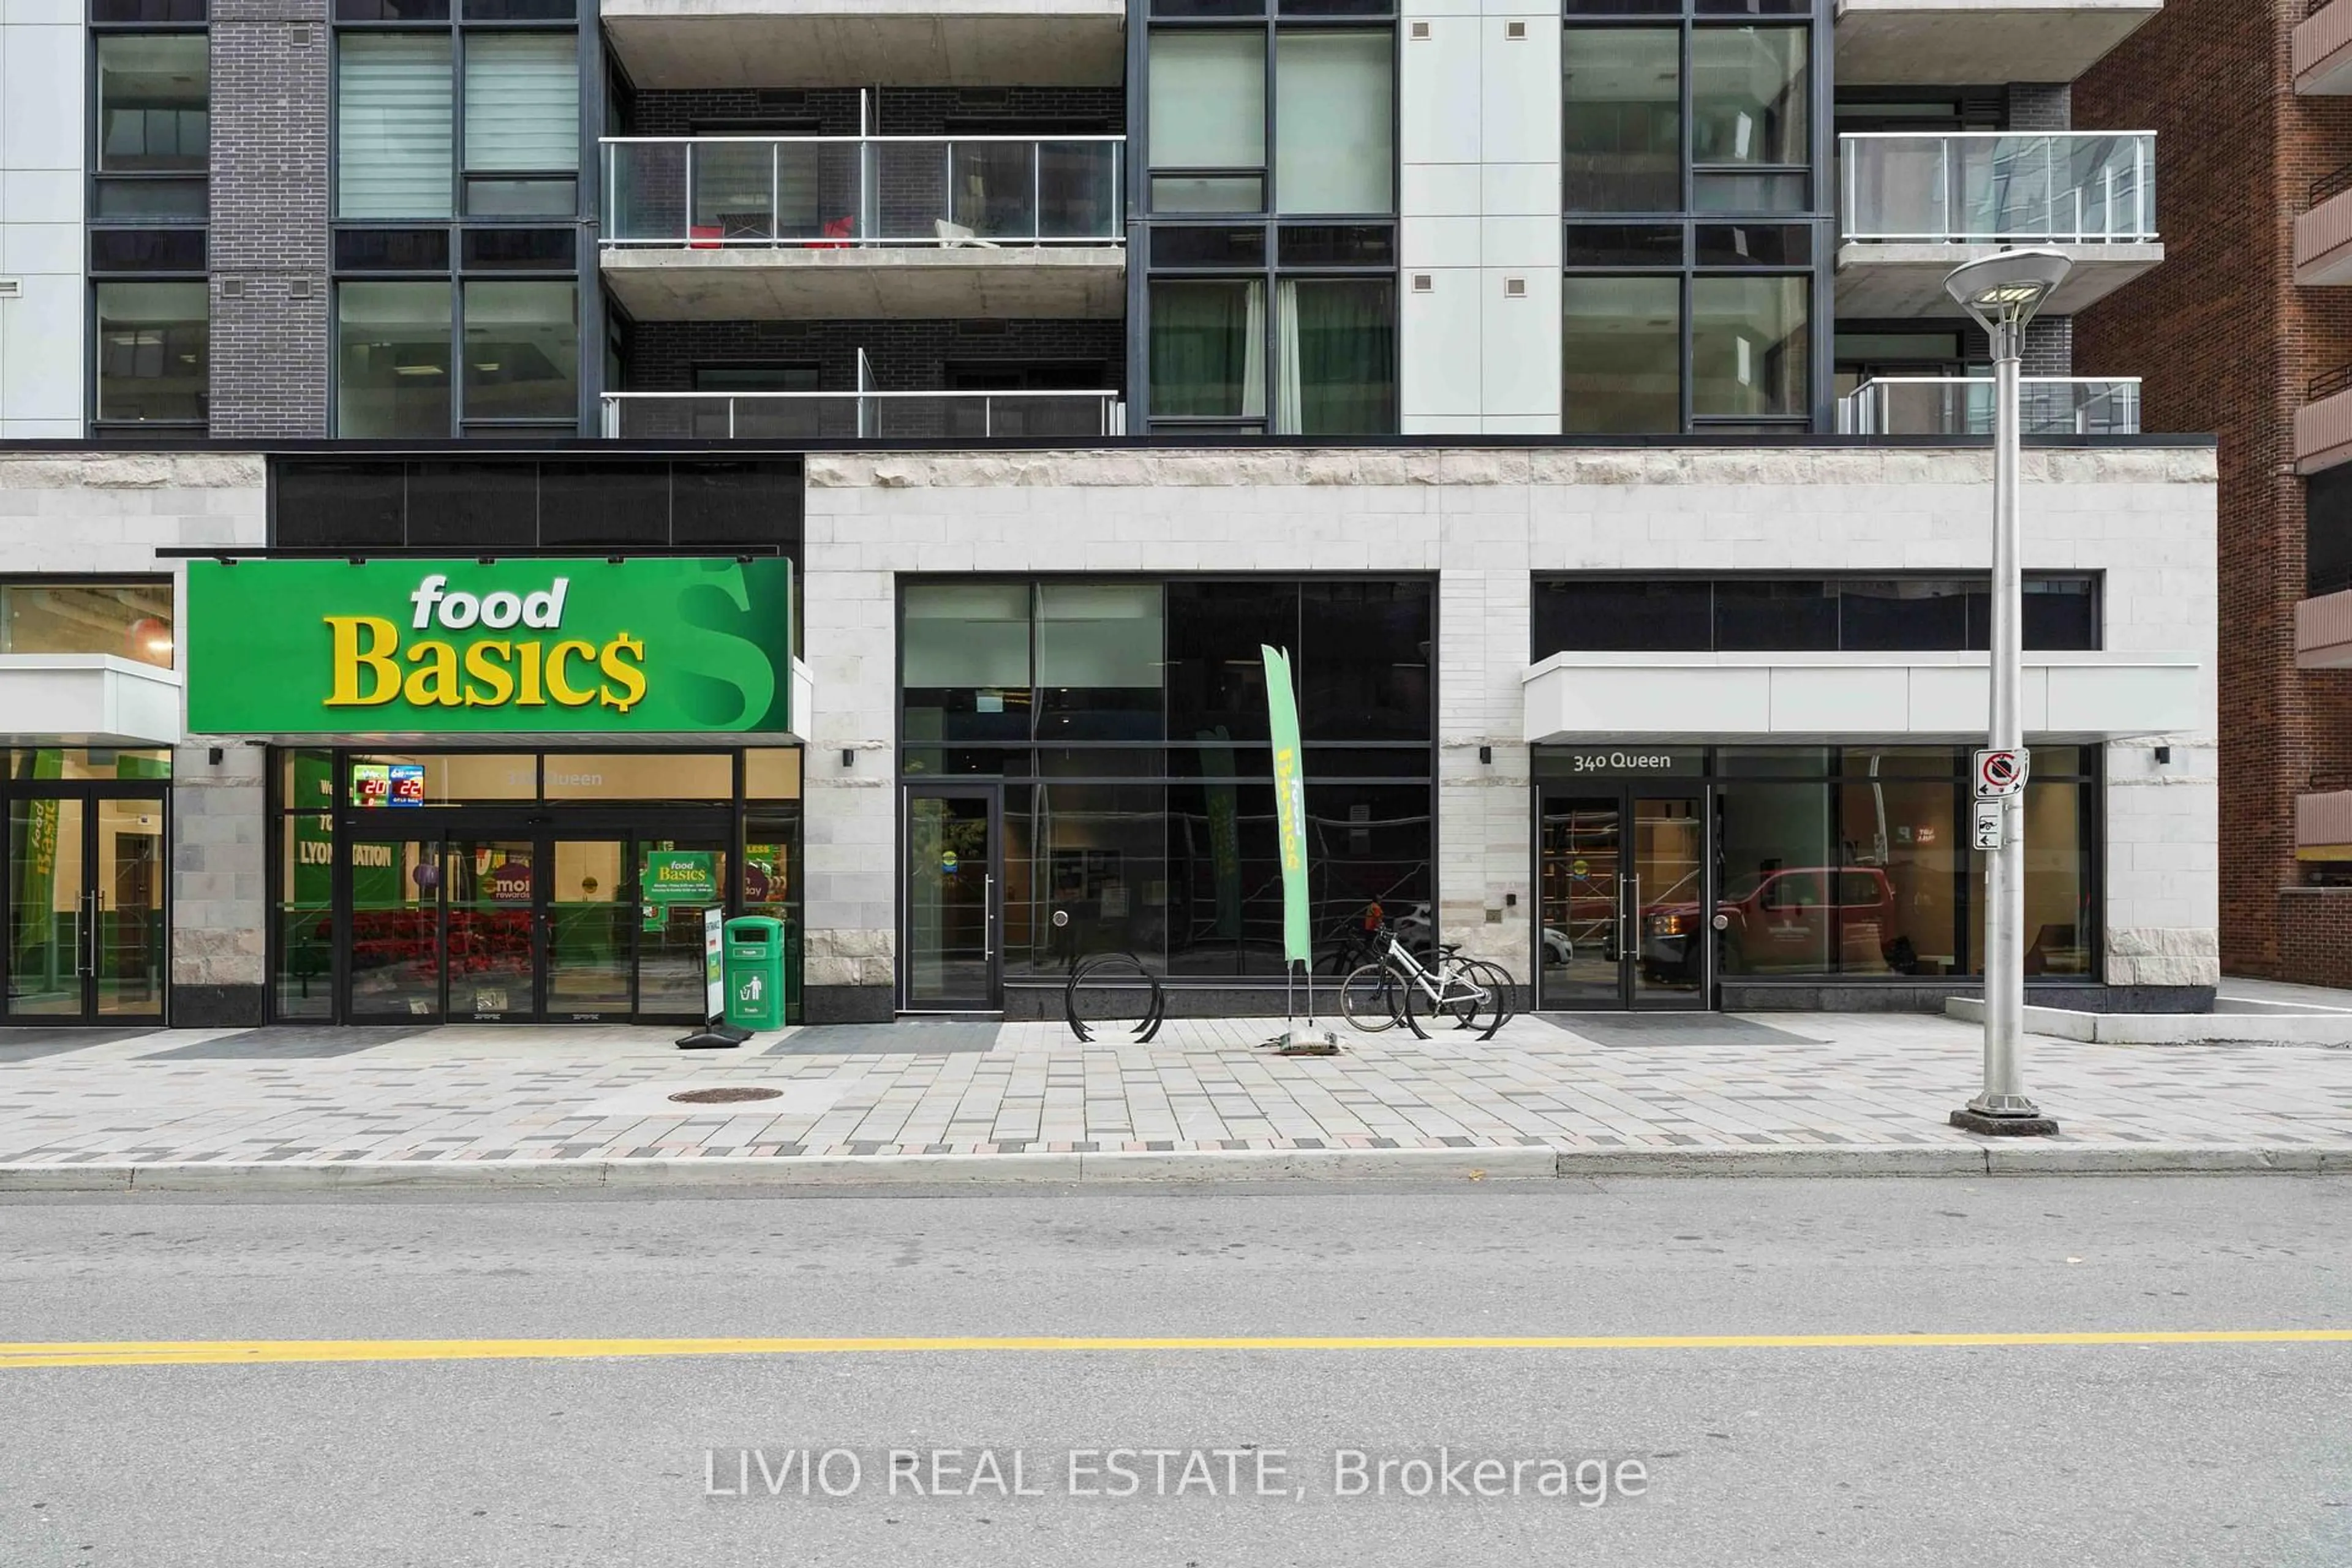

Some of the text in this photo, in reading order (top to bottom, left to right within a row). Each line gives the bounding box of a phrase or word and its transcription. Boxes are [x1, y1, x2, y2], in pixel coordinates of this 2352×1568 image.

[410, 575, 569, 630] food
[1574, 752, 1671, 772] 340 Queen
[400, 780, 421, 795] 22
[671, 861, 695, 870] food
